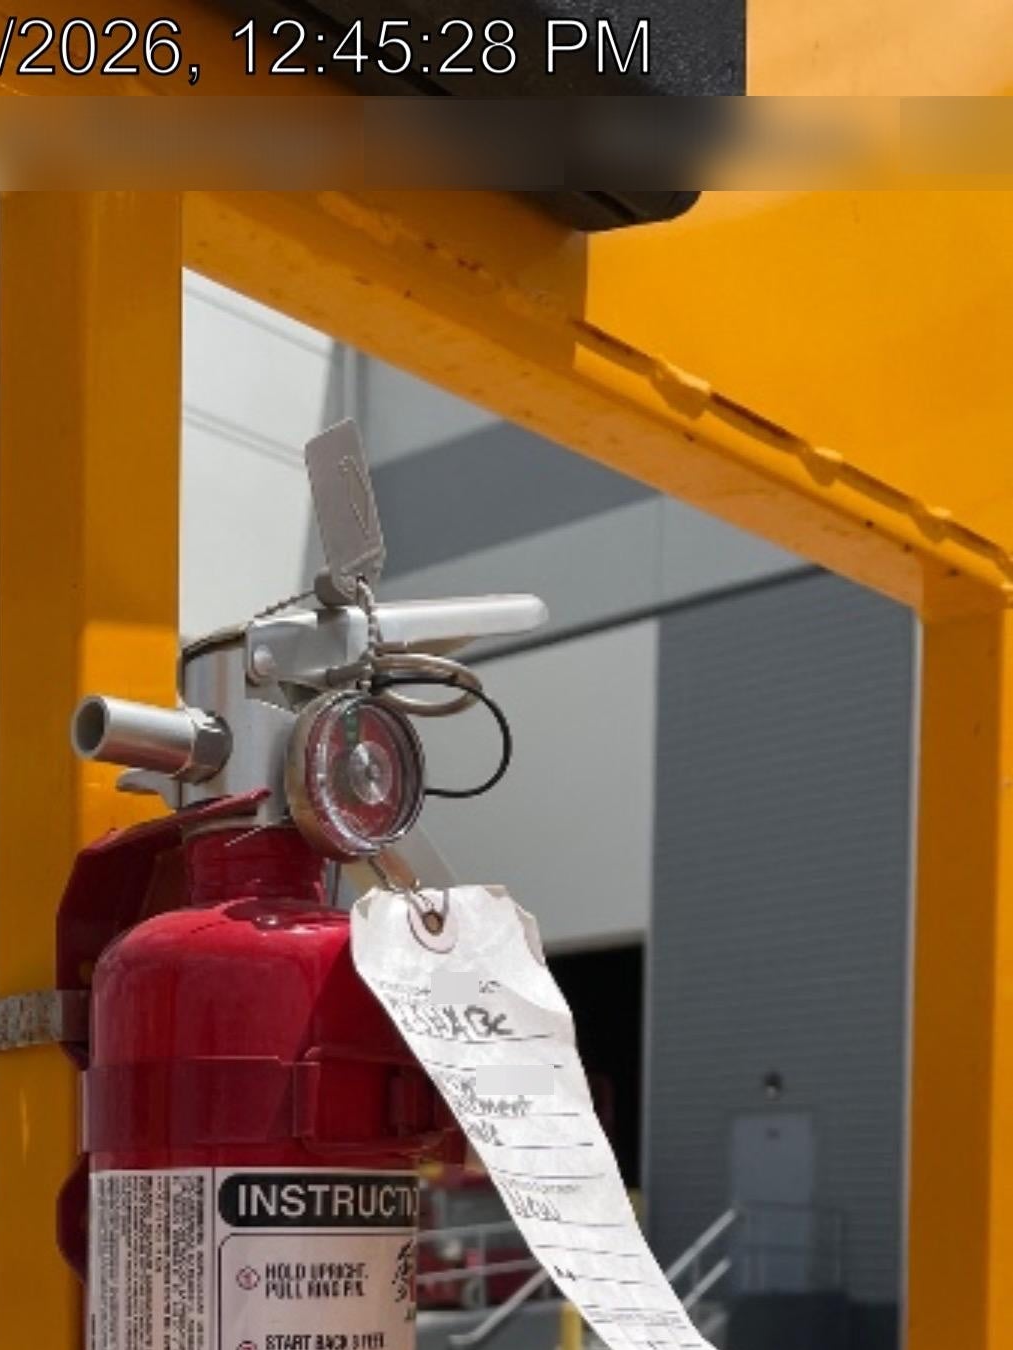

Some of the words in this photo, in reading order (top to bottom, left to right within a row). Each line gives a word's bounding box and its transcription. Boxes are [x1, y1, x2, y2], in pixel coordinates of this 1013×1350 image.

[265, 1263, 306, 1281] HOLD
[265, 1281, 303, 1299] PULL
[265, 1334, 312, 1350] START
[315, 1334, 349, 1350] BACK
